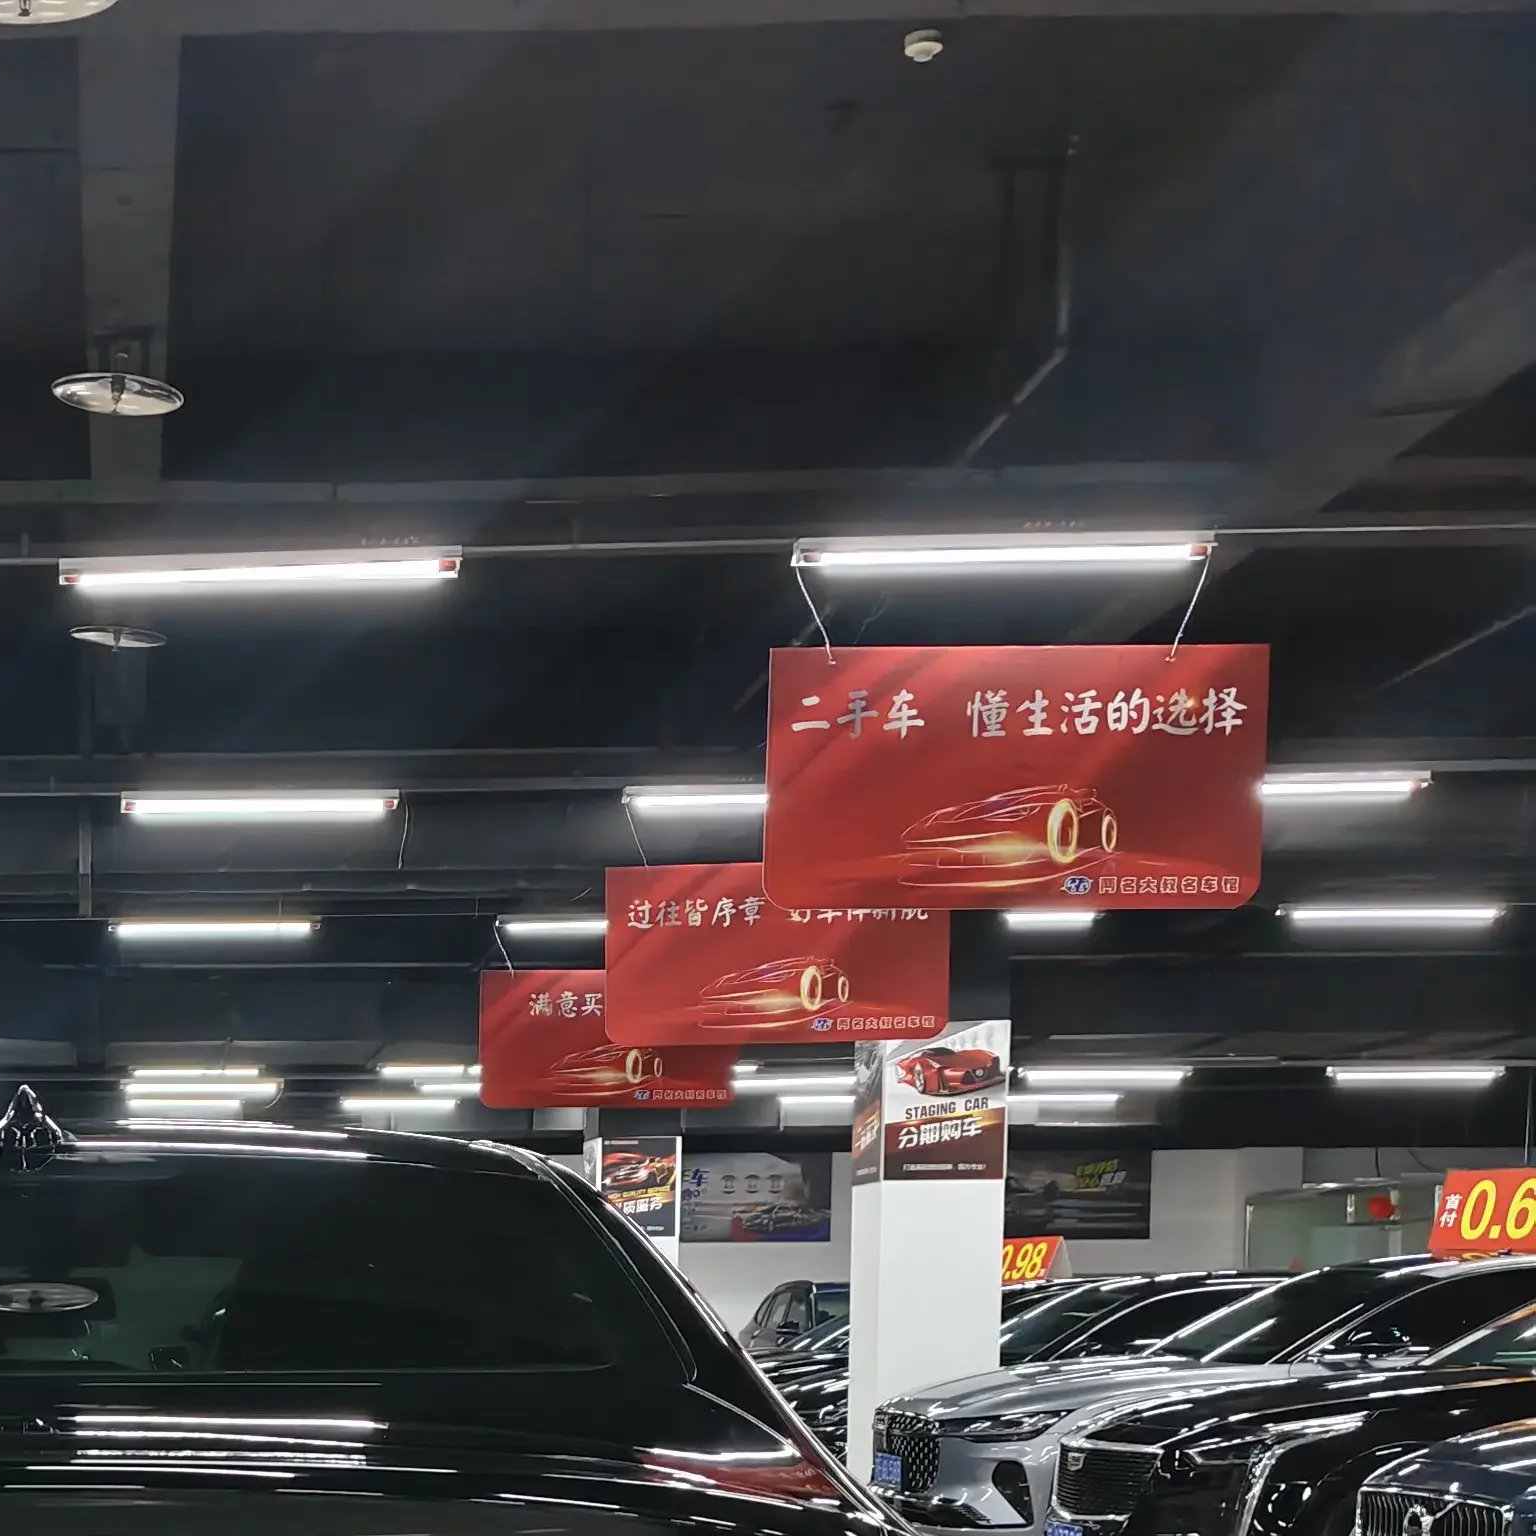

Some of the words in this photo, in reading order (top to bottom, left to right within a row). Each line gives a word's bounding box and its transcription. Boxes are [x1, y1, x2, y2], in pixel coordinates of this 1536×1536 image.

[791, 688, 925, 740] 二手车
[966, 686, 1248, 738] 懂生活的选择
[627, 897, 765, 929] 过往皆序章
[528, 990, 604, 1018] 满意买
[905, 1101, 957, 1120] STAGING
[964, 1096, 990, 1112] CAR
[898, 1116, 983, 1149] 分期购车
[614, 1196, 663, 1215] 质服务
[1439, 1193, 1463, 1228] 首付
